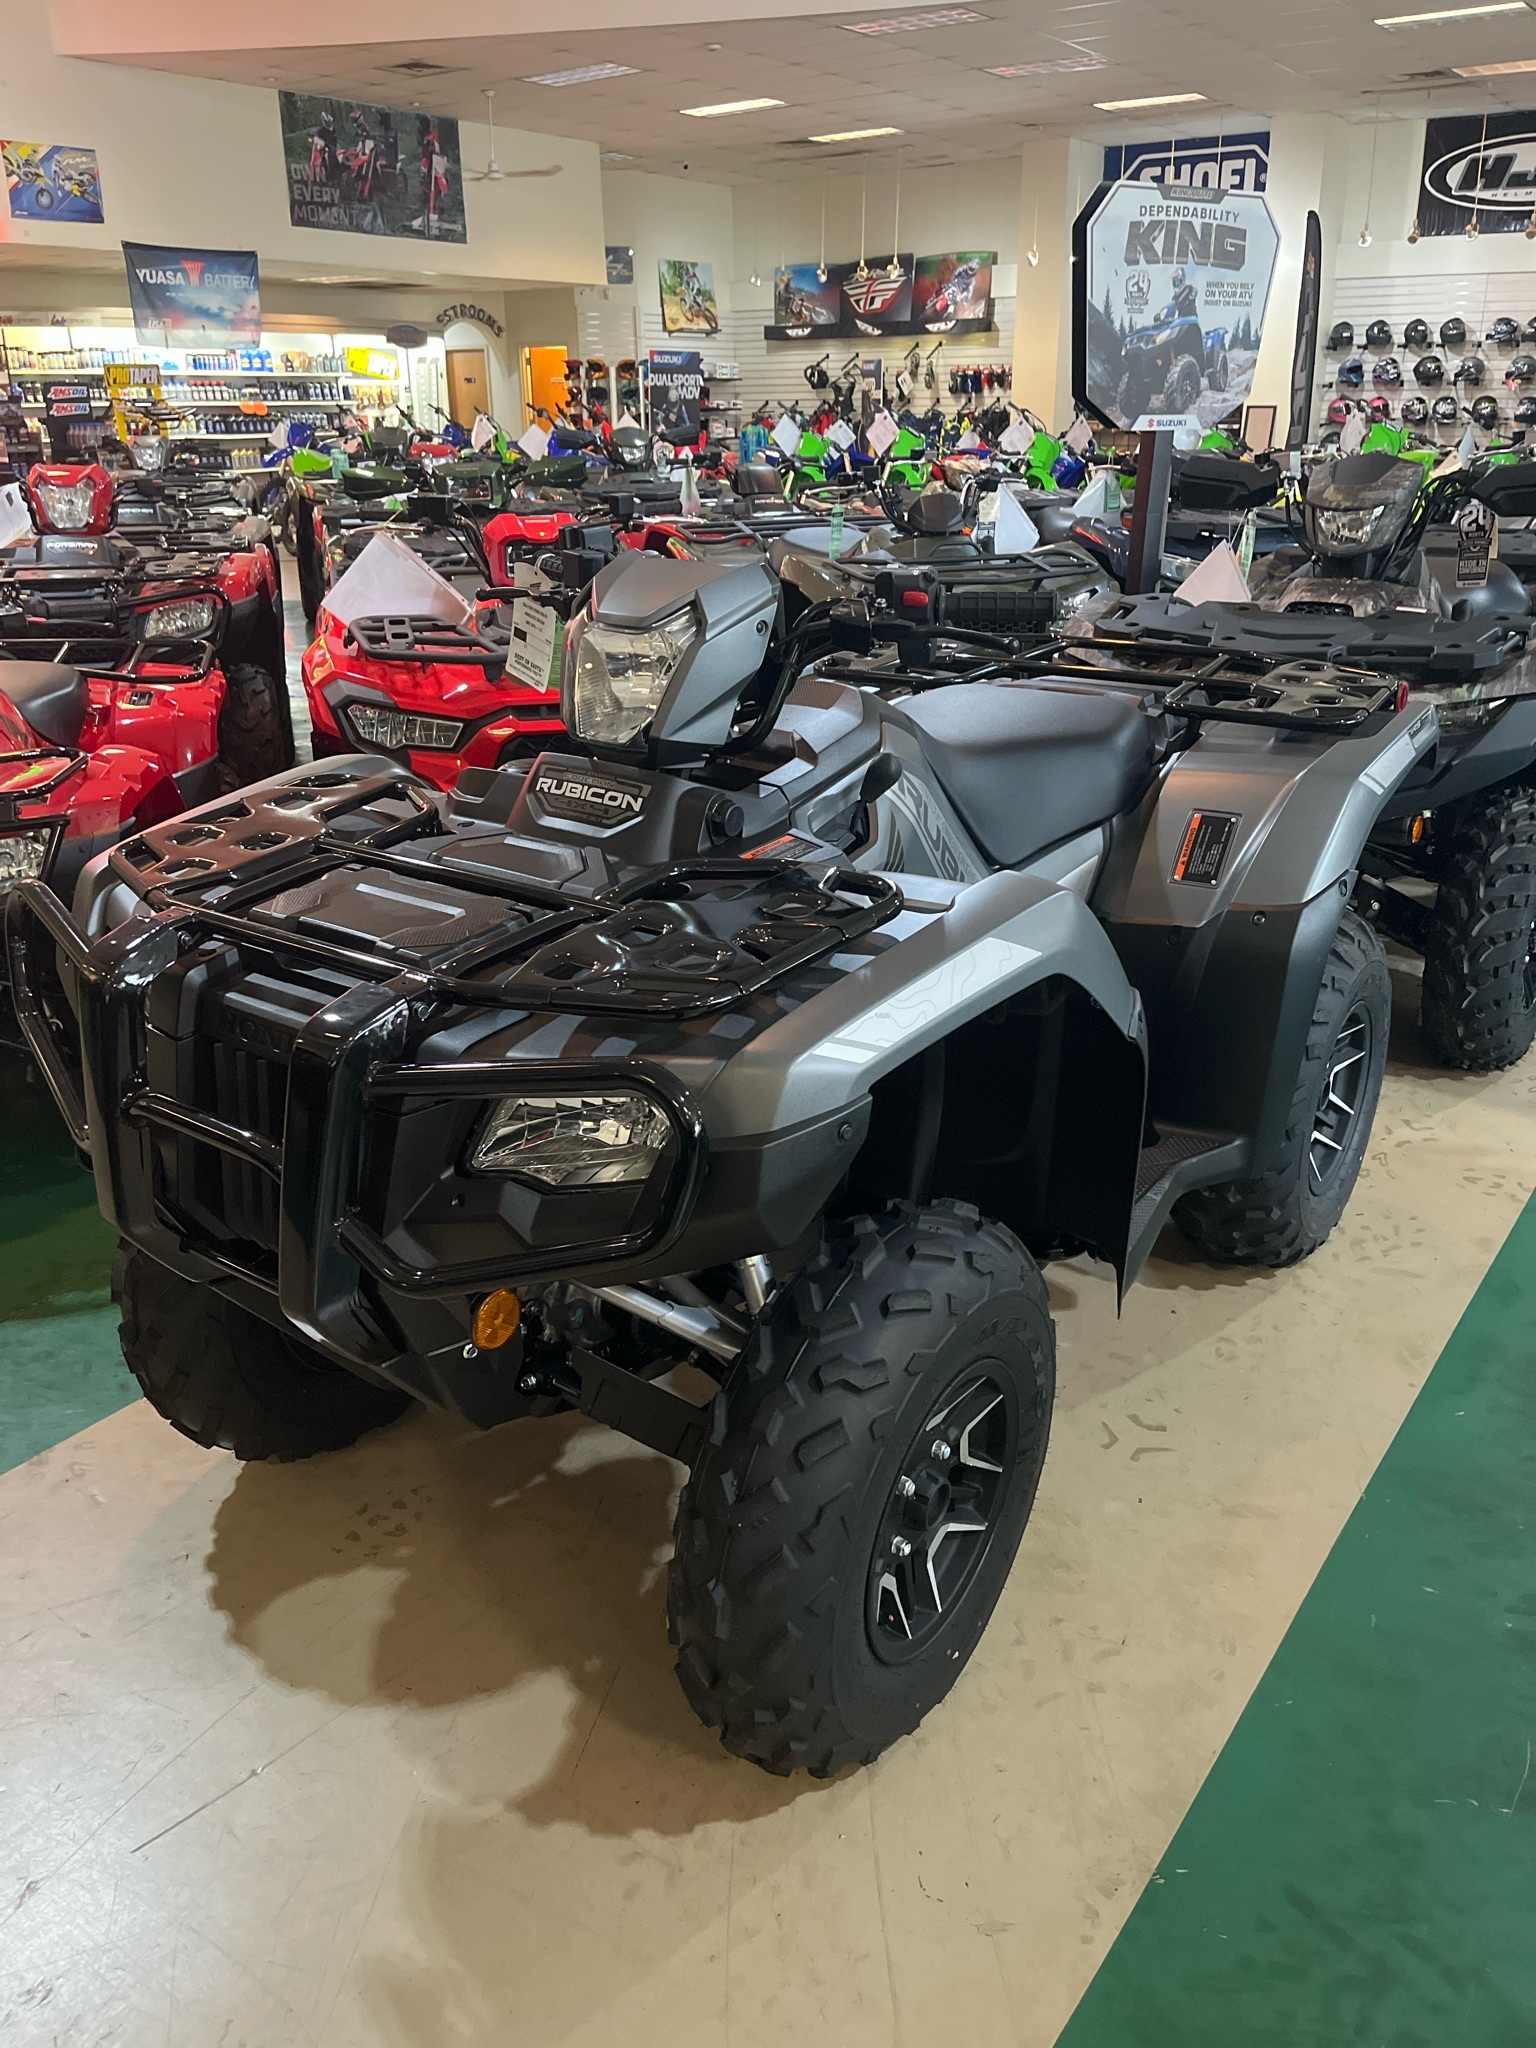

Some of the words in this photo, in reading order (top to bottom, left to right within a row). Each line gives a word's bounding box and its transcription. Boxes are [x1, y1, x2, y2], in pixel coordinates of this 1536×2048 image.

[290, 163, 327, 183] OWN
[293, 183, 340, 204] EVERY
[293, 204, 359, 227] MOMENT
[1139, 205, 1240, 223] DEPENDABILITY
[1123, 219, 1248, 272] KING
[136, 268, 185, 286] YUASA
[205, 273, 255, 290] BATTERY
[1128, 269, 1149, 293] 24
[1206, 281, 1225, 289] WHEN
[1226, 282, 1239, 290] YOU
[1240, 282, 1255, 290] RELY
[1205, 289, 1216, 298] ON
[1218, 290, 1238, 299] YOUR
[1222, 299, 1231, 307] ON
[653, 354, 682, 364] SUZUKI
[51, 386, 87, 399] AMSOIL
[53, 403, 89, 416] AMSOIL
[1156, 419, 1187, 427] SUZUKI
[1462, 503, 1491, 532] 24
[46, 541, 98, 550] FOREMAN
[563, 772, 616, 789] FOREMAN
[535, 777, 644, 812] RUBICON
[1183, 827, 1197, 859] WARNING
